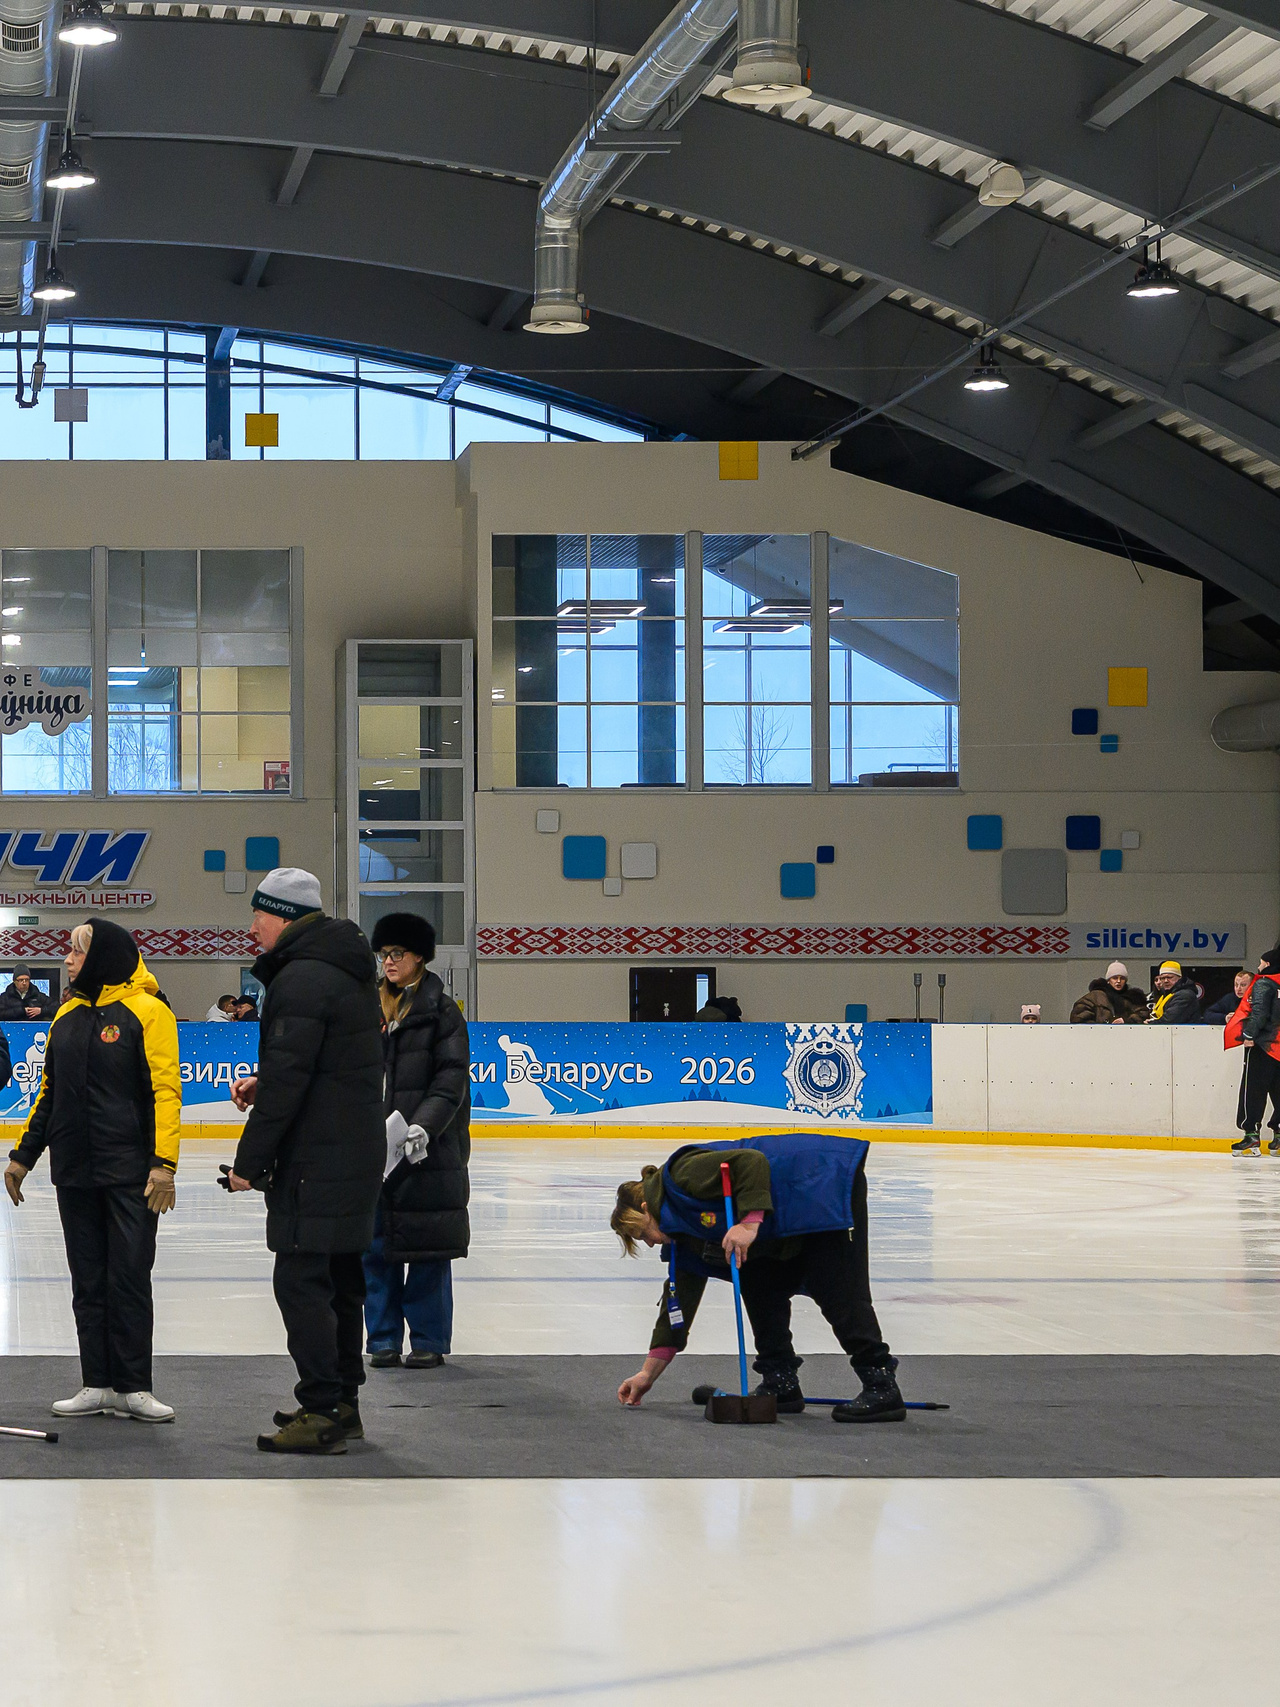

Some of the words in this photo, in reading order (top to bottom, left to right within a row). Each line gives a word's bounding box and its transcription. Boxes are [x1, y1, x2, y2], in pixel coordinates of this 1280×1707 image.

[91, 893, 153, 907] ЦЕНТР
[1086, 928, 1230, 953] silichy.by
[505, 1055, 653, 1090] Беларусь
[679, 1056, 756, 1085] 2026
